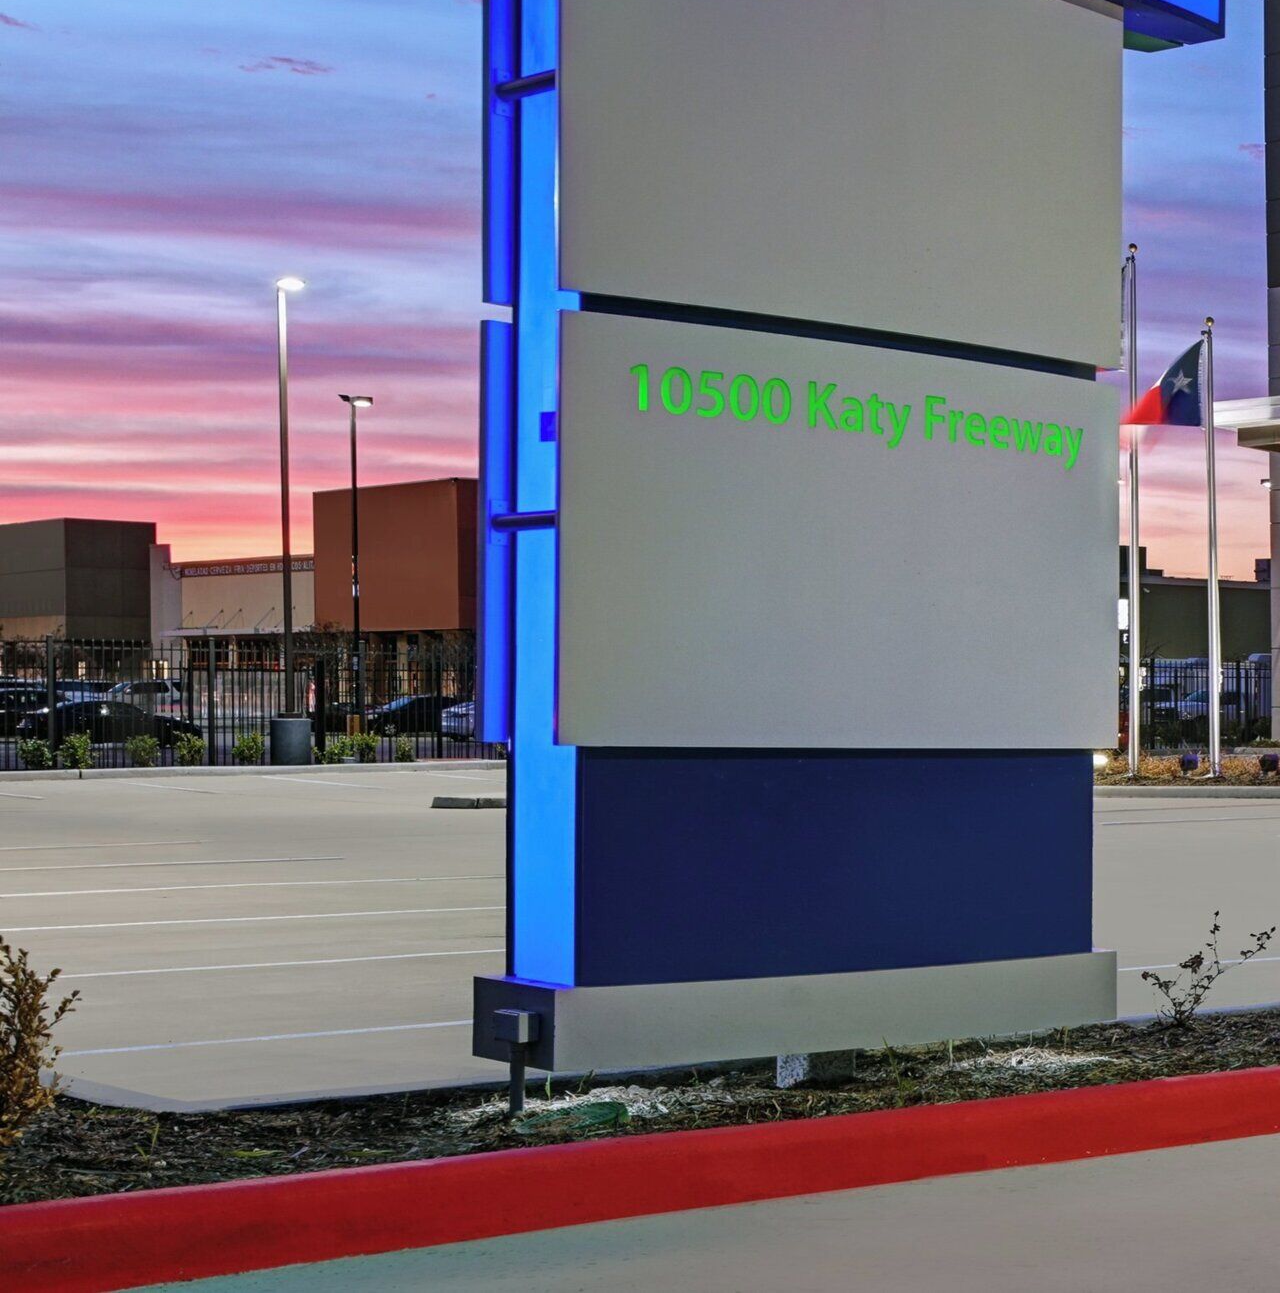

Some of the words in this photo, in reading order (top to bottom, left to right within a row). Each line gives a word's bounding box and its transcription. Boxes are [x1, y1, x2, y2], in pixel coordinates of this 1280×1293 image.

[629, 363, 792, 425] 10500
[807, 381, 911, 450] Katy
[924, 395, 1084, 472] Freeway
